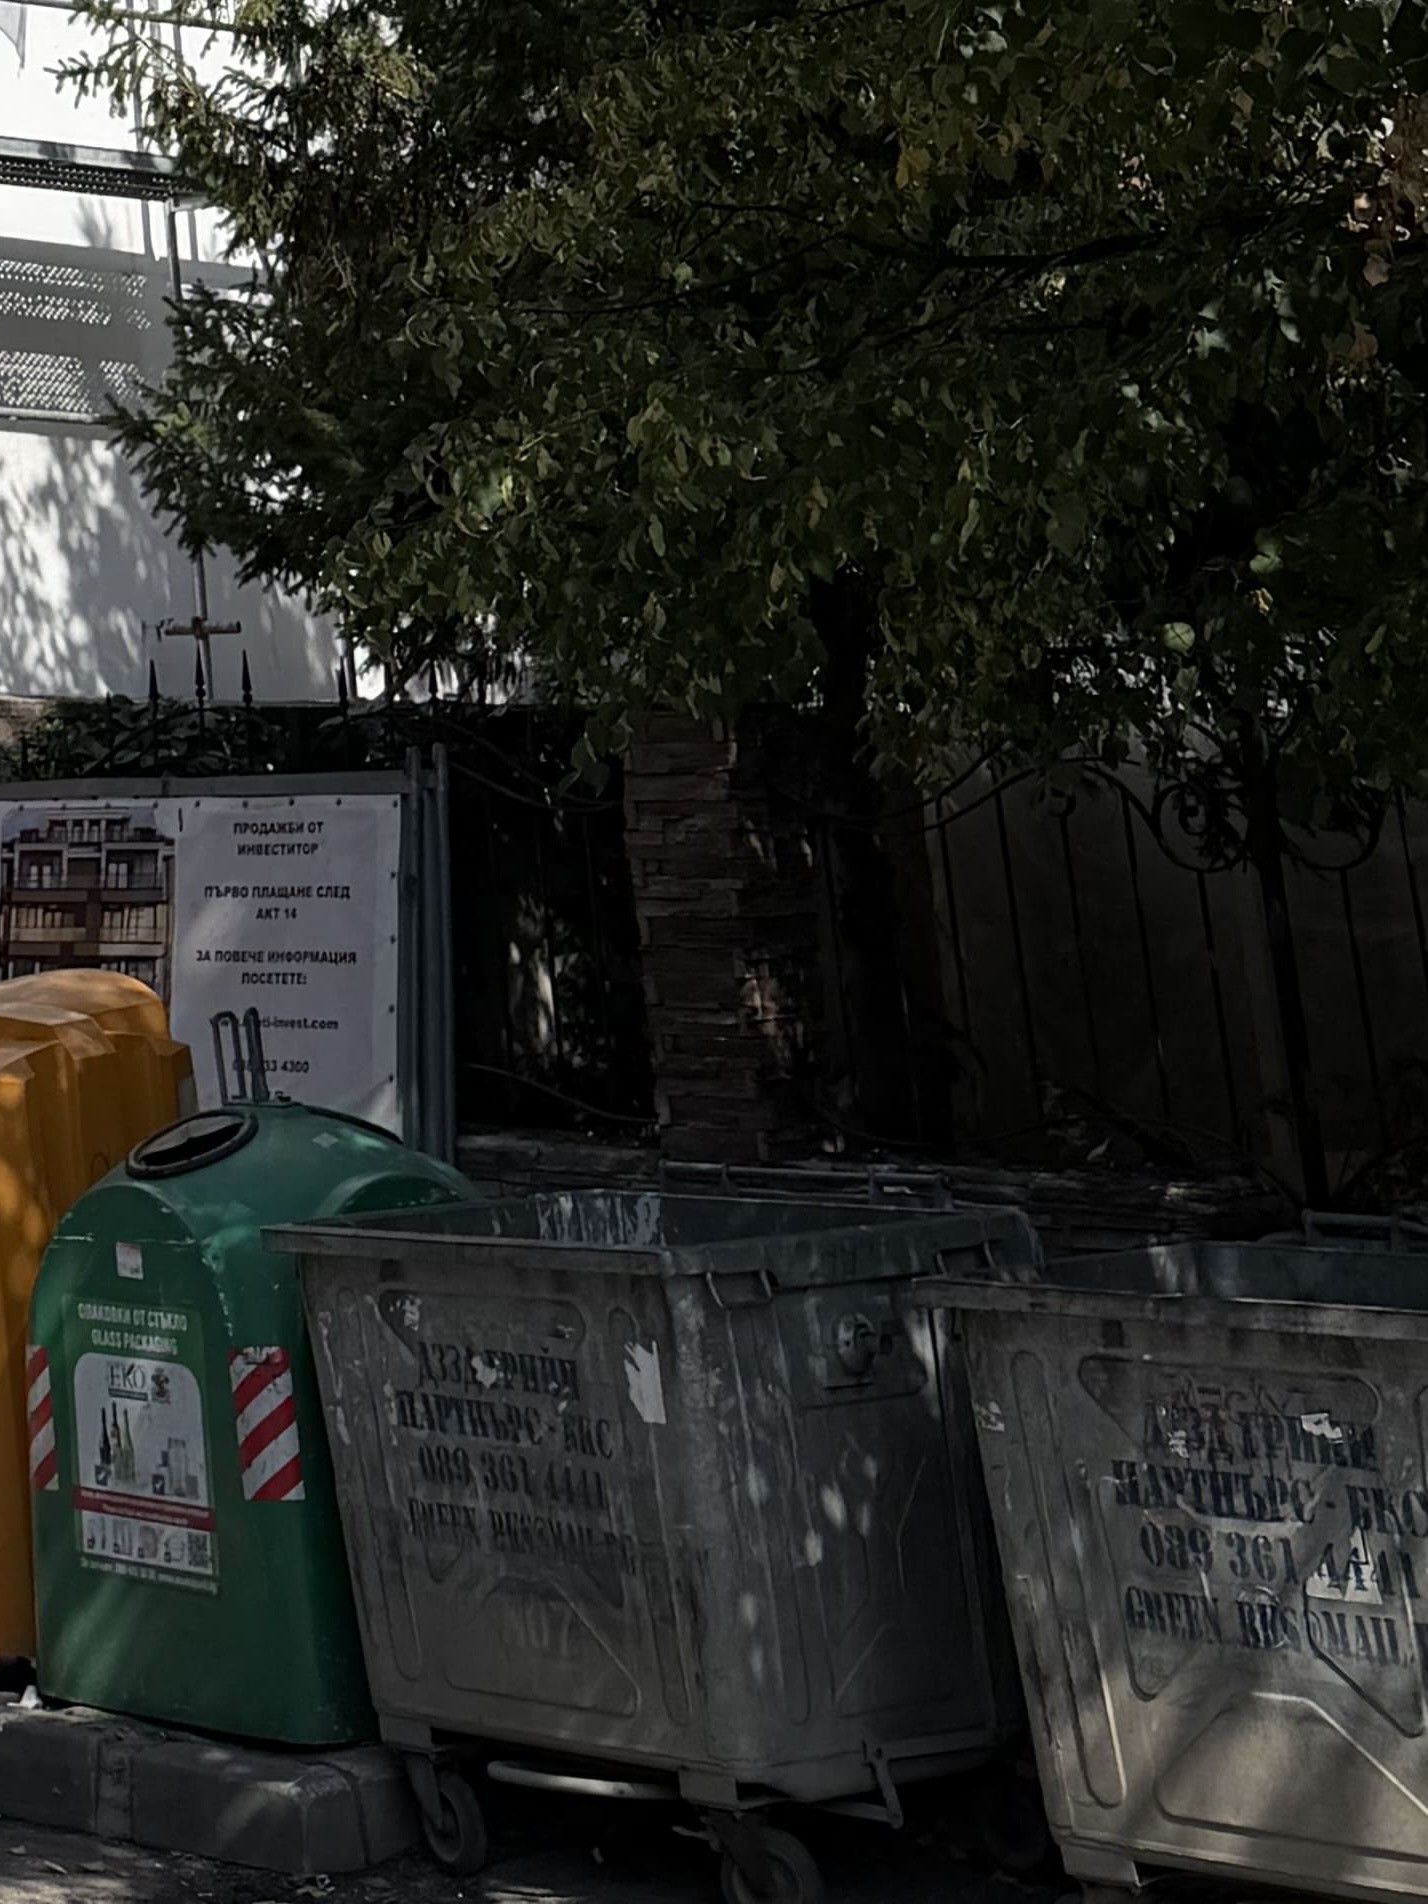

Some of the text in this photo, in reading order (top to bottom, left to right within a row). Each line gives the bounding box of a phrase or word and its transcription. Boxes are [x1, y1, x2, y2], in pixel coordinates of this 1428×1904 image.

[233, 821, 324, 836] ПРОДАЖБИ ОТ
[237, 843, 319, 856] ИНВЕСТИТОР
[204, 885, 351, 900] ПЪРВО ПЛАЩАНЕ СЛЕД
[255, 907, 280, 920] АКТ
[196, 950, 357, 965] ЗА ПОВЕЧЕ ИНФОРМАЦИЯ
[241, 972, 307, 985] ПОСЕТЕТЕ:
[77, 1302, 188, 1332] ОПАКОВКИ ОТ СТЪКЛО
[91, 1328, 179, 1356] GLASS PACKAGING
[1139, 1523, 1214, 1575] 089
[1227, 1531, 1301, 1586] 361
